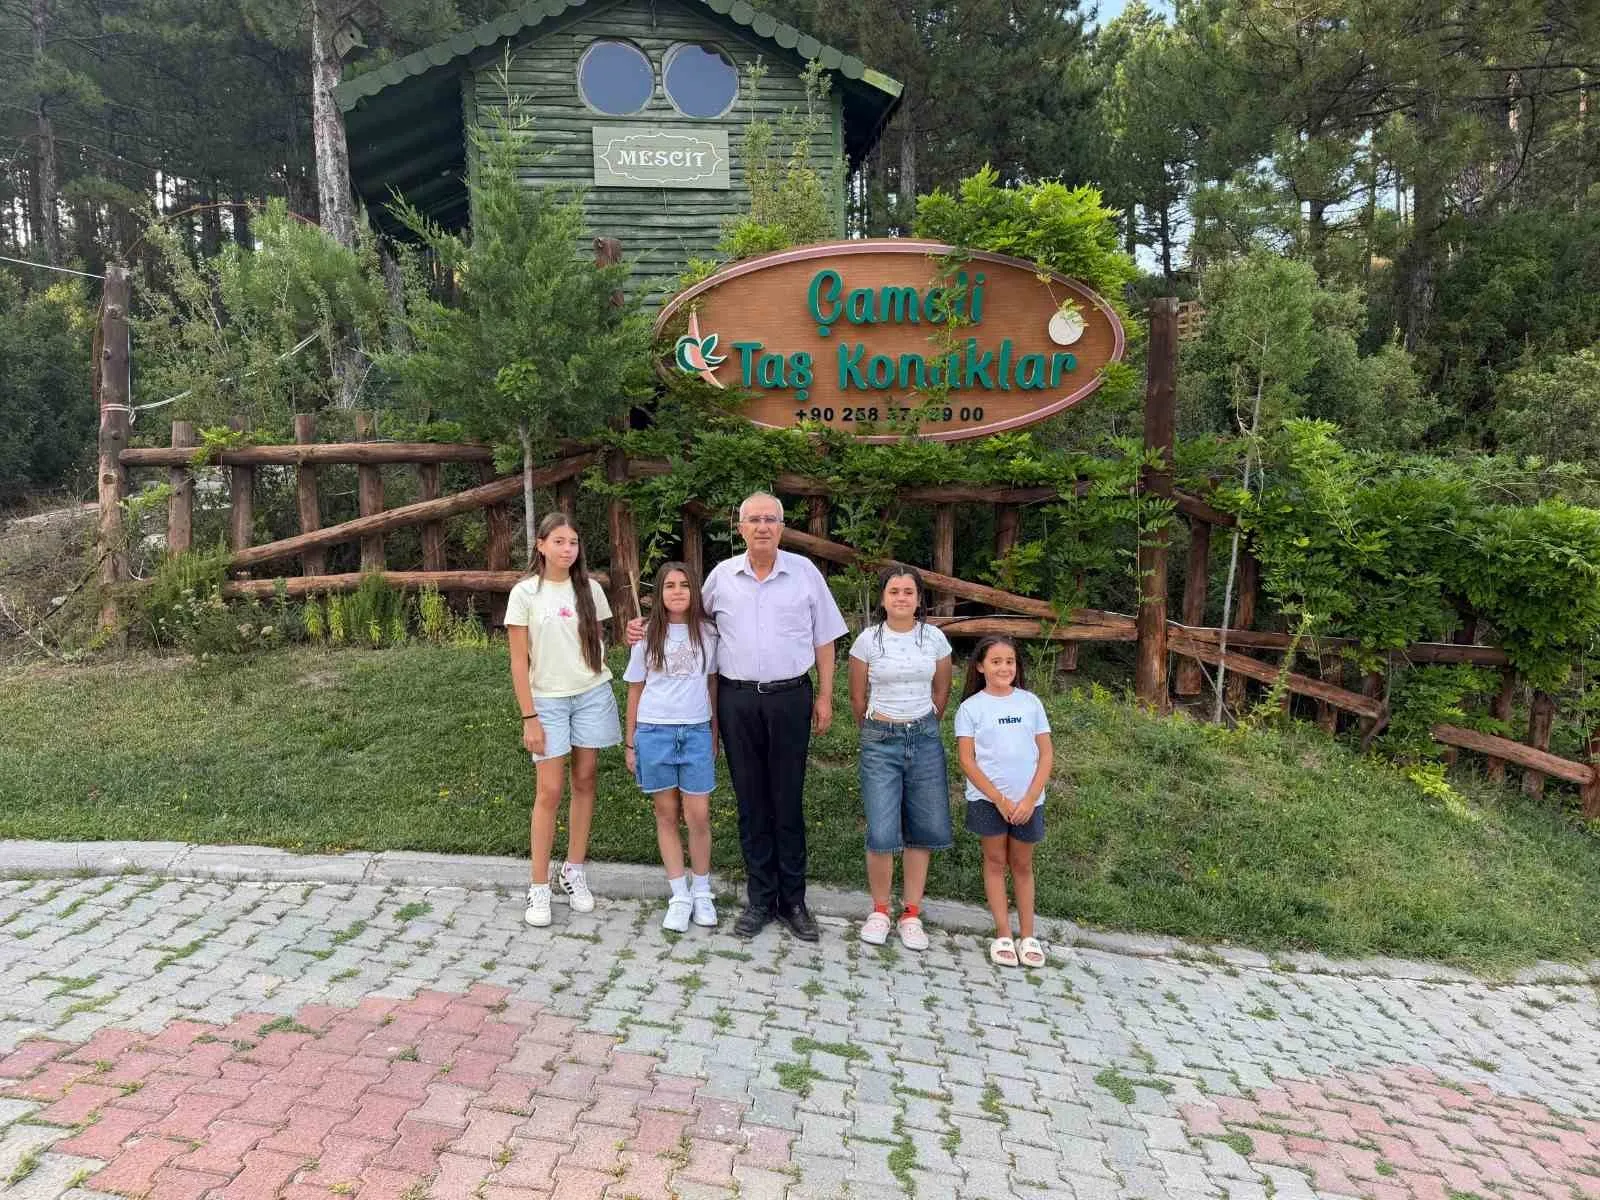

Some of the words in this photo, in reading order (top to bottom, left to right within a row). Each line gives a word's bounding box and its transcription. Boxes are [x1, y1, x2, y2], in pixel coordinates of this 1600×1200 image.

[807, 268, 986, 337] Çameli
[731, 341, 814, 400] Taş
[837, 336, 1078, 392] Konaklar
[795, 407, 834, 422] +90
[842, 407, 879, 422] 258
[960, 407, 984, 422] 00
[998, 715, 1022, 724] miav
